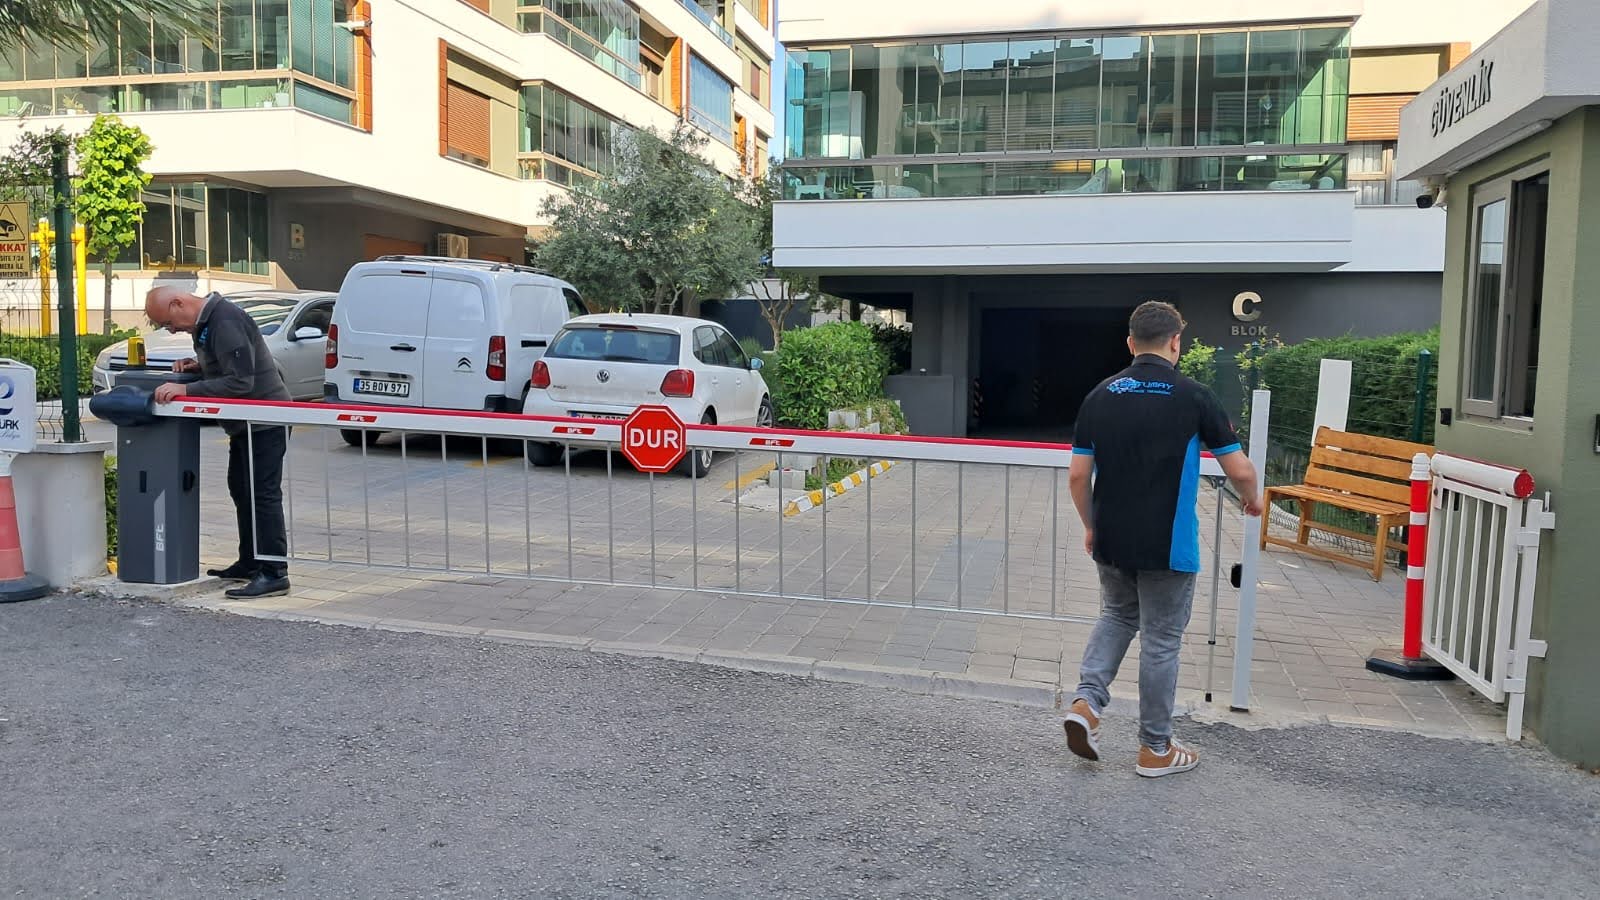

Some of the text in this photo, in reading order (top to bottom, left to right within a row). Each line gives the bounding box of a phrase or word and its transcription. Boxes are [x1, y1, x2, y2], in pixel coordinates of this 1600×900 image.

[1431, 59, 1494, 138] GÜVENLİK
[290, 223, 305, 249] B
[1232, 291, 1262, 322] C
[1231, 325, 1268, 336] BLOK
[360, 381, 371, 391] 35
[391, 383, 407, 394] 971
[630, 428, 680, 449] DUR
